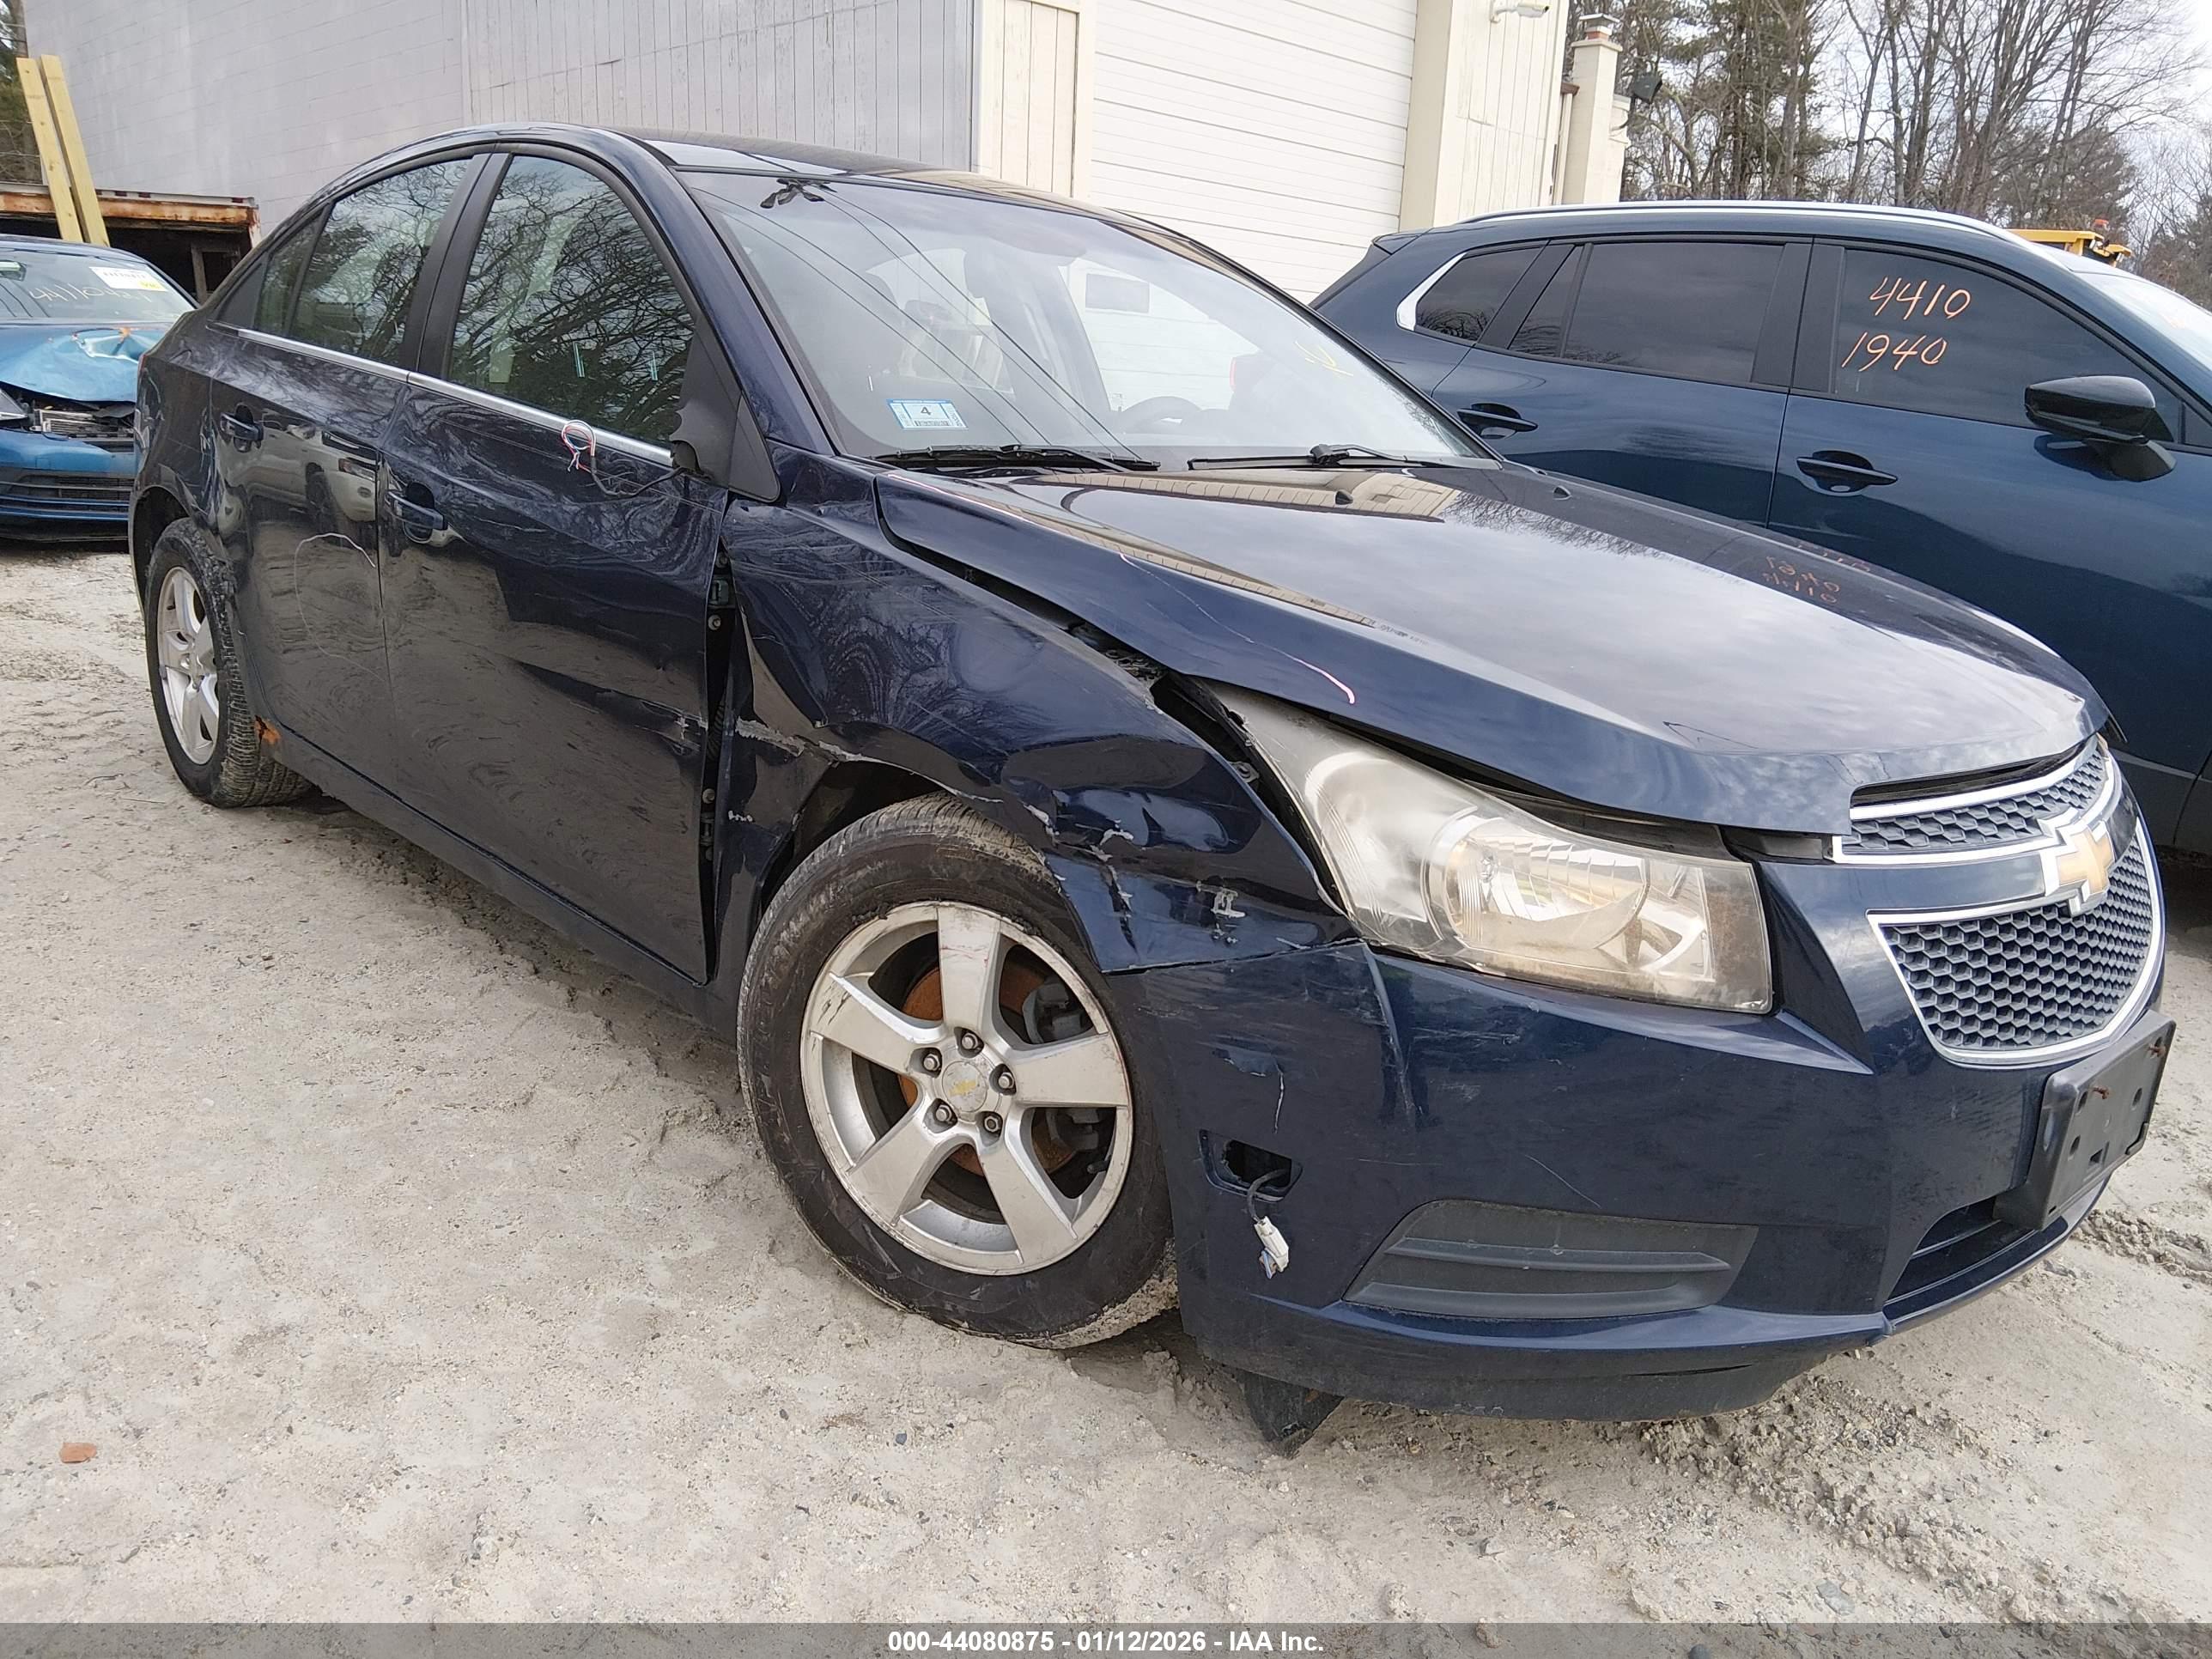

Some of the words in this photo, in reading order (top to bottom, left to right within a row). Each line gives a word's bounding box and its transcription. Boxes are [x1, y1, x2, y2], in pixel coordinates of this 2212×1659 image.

[1869, 276, 1972, 320] 4410
[1840, 331, 1948, 372] 1940
[921, 406, 932, 416] 4
